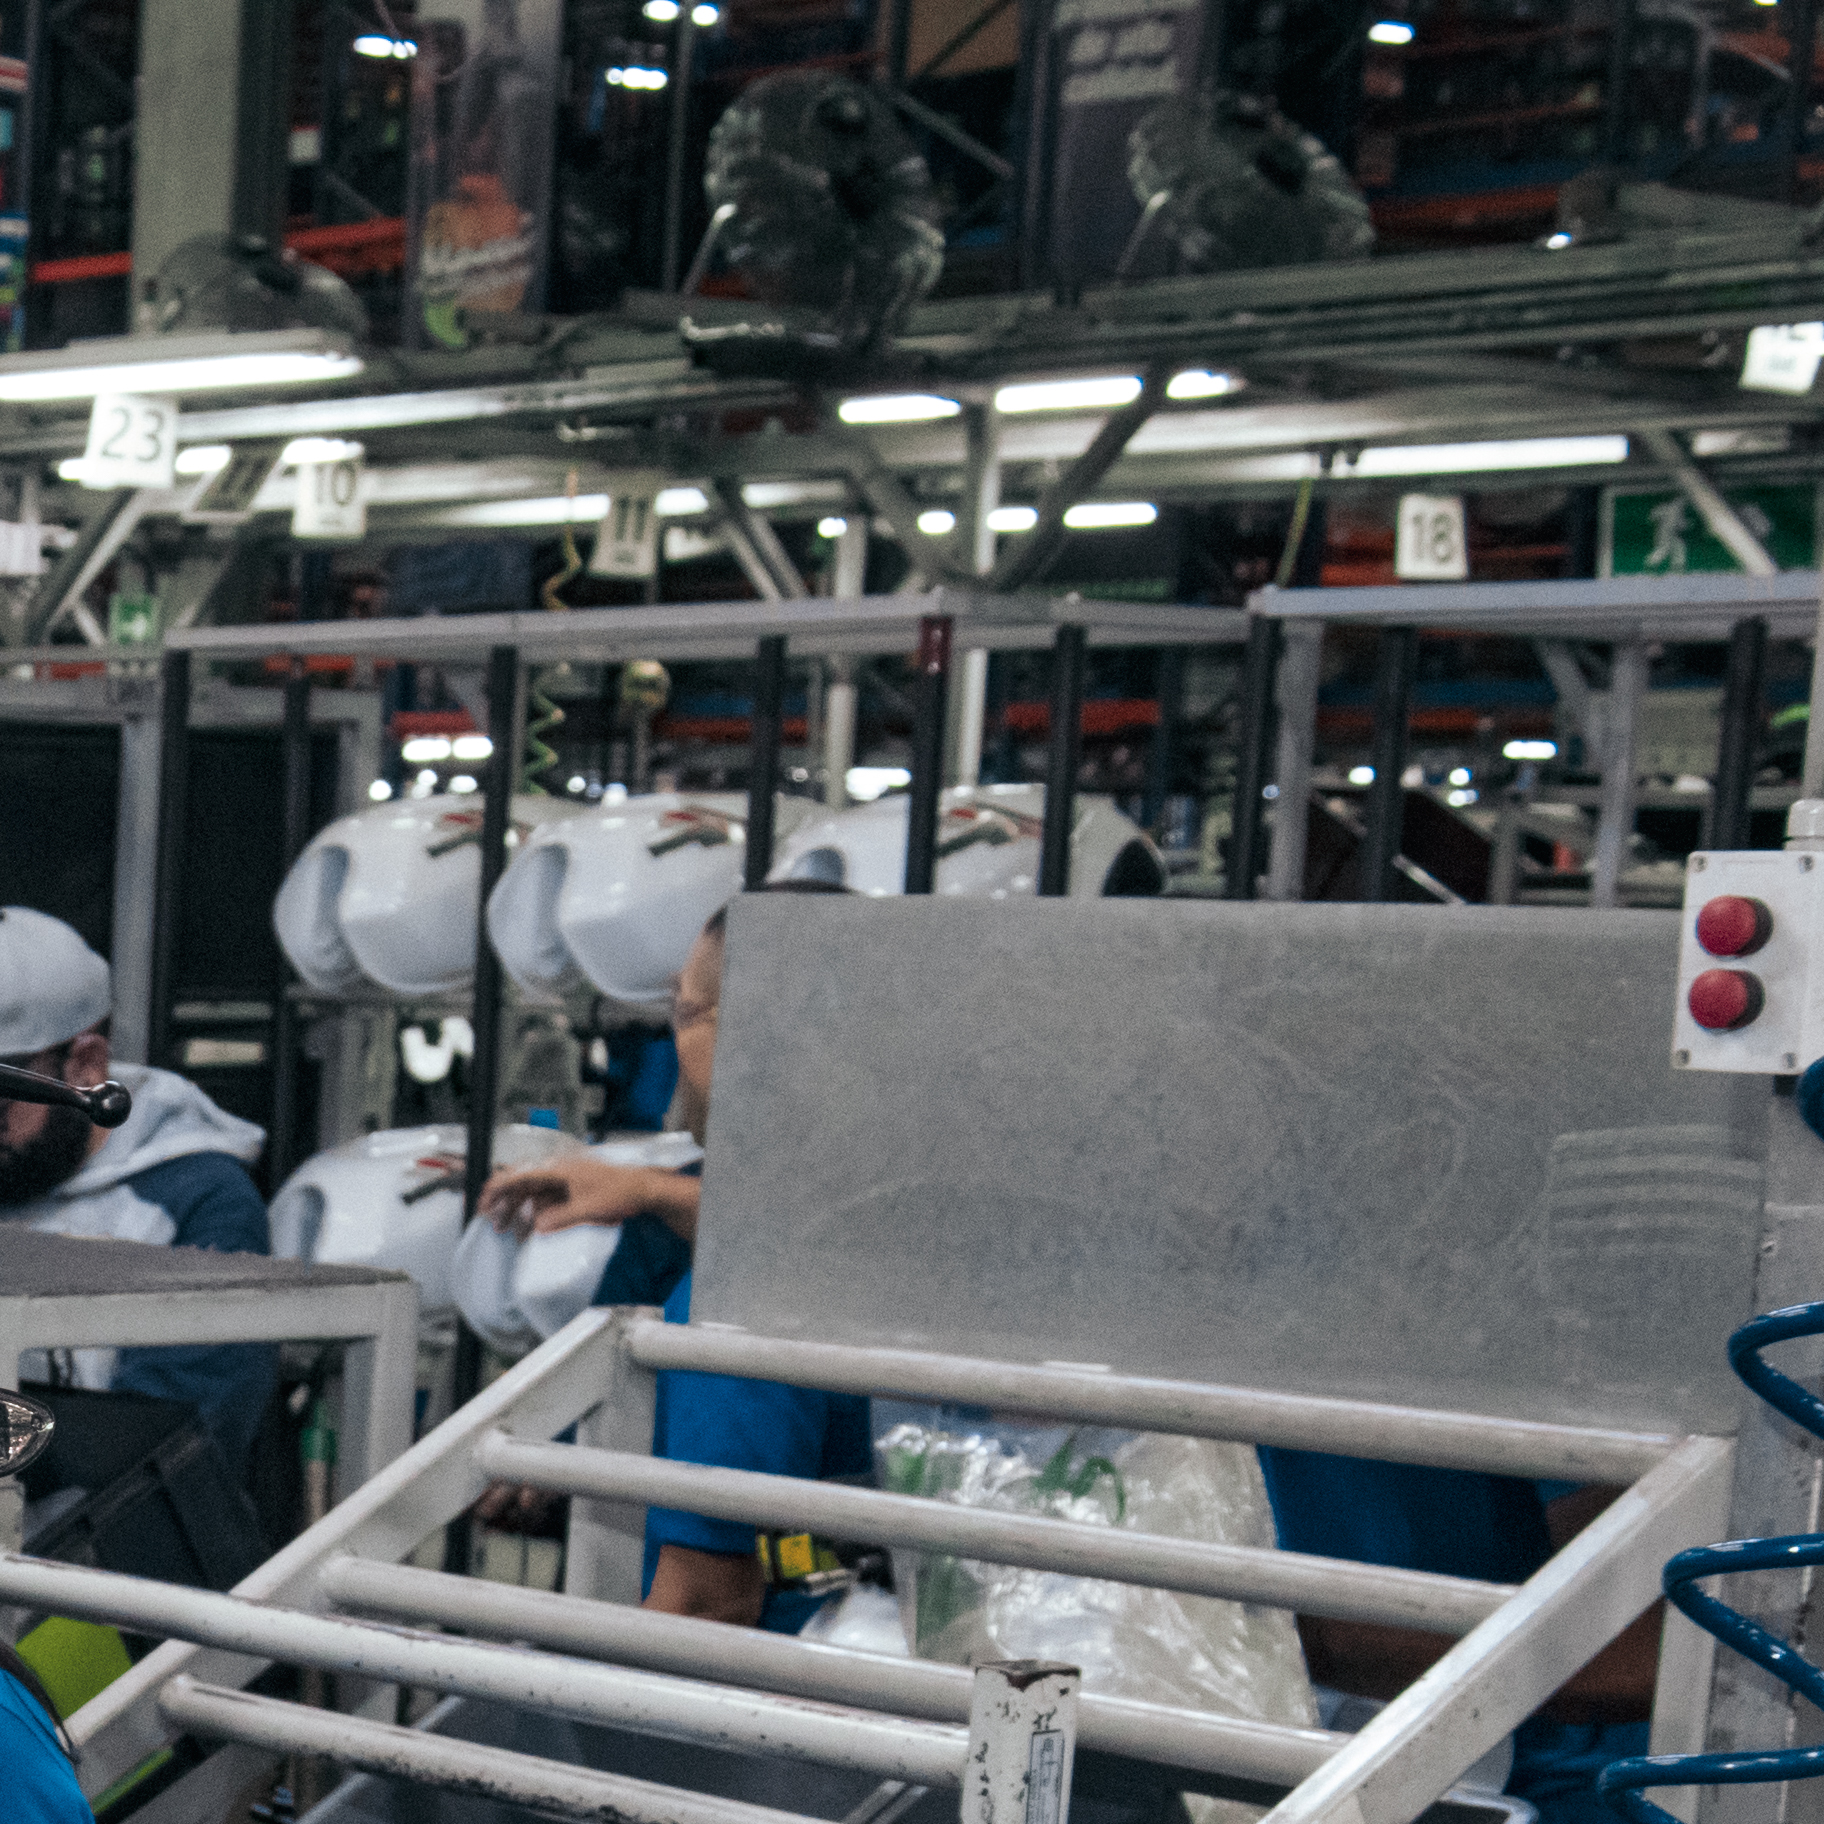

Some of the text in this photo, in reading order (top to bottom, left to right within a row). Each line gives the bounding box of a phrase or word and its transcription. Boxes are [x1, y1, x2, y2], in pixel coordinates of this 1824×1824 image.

[100, 406, 163, 461] 23
[314, 459, 354, 506] 10
[1413, 511, 1453, 563] 18
